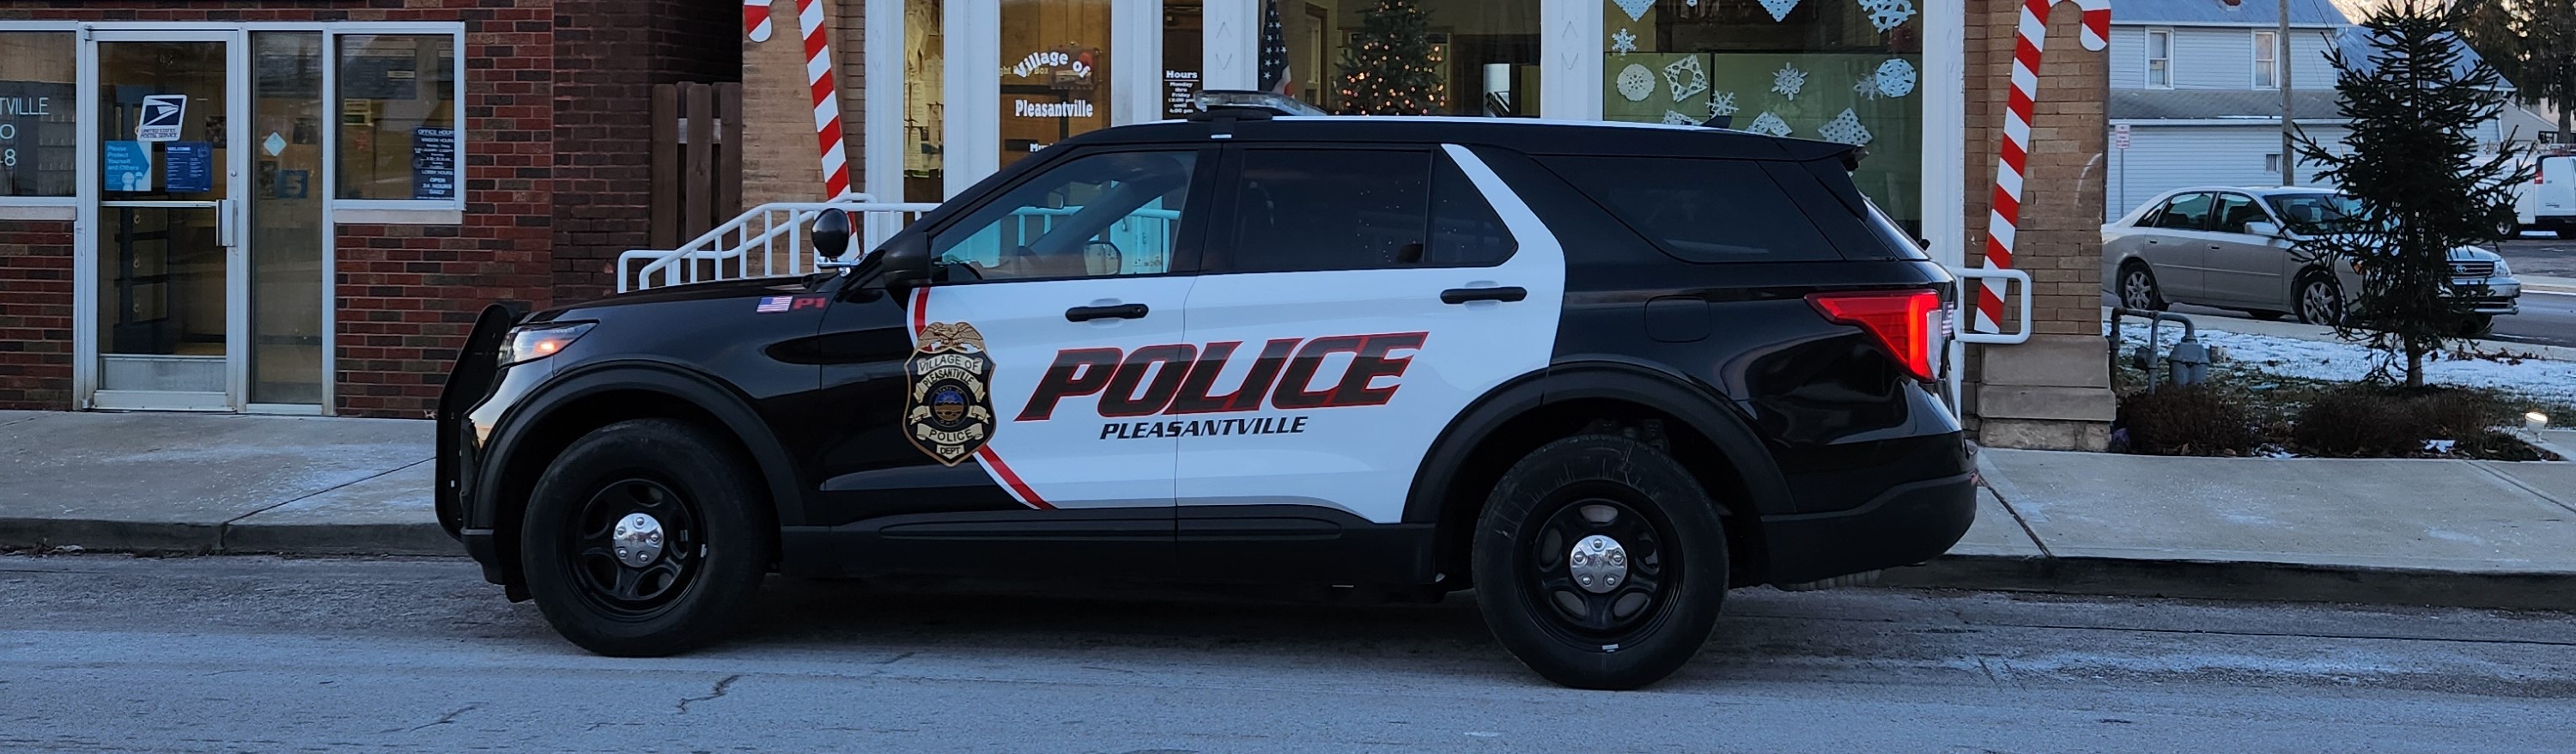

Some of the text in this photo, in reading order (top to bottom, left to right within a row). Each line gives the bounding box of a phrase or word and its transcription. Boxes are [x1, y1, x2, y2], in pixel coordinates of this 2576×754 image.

[1013, 52, 1091, 78] Village of
[1166, 70, 1198, 78] Hours
[1015, 99, 1093, 118] Pleasantville
[919, 356, 980, 372] VILLAGE OF
[922, 368, 974, 386] PLEASANTVILLE
[1013, 331, 1430, 422] POLICE
[928, 429, 974, 442] POLICE
[1099, 417, 1309, 440] PLEASANTVILLE
